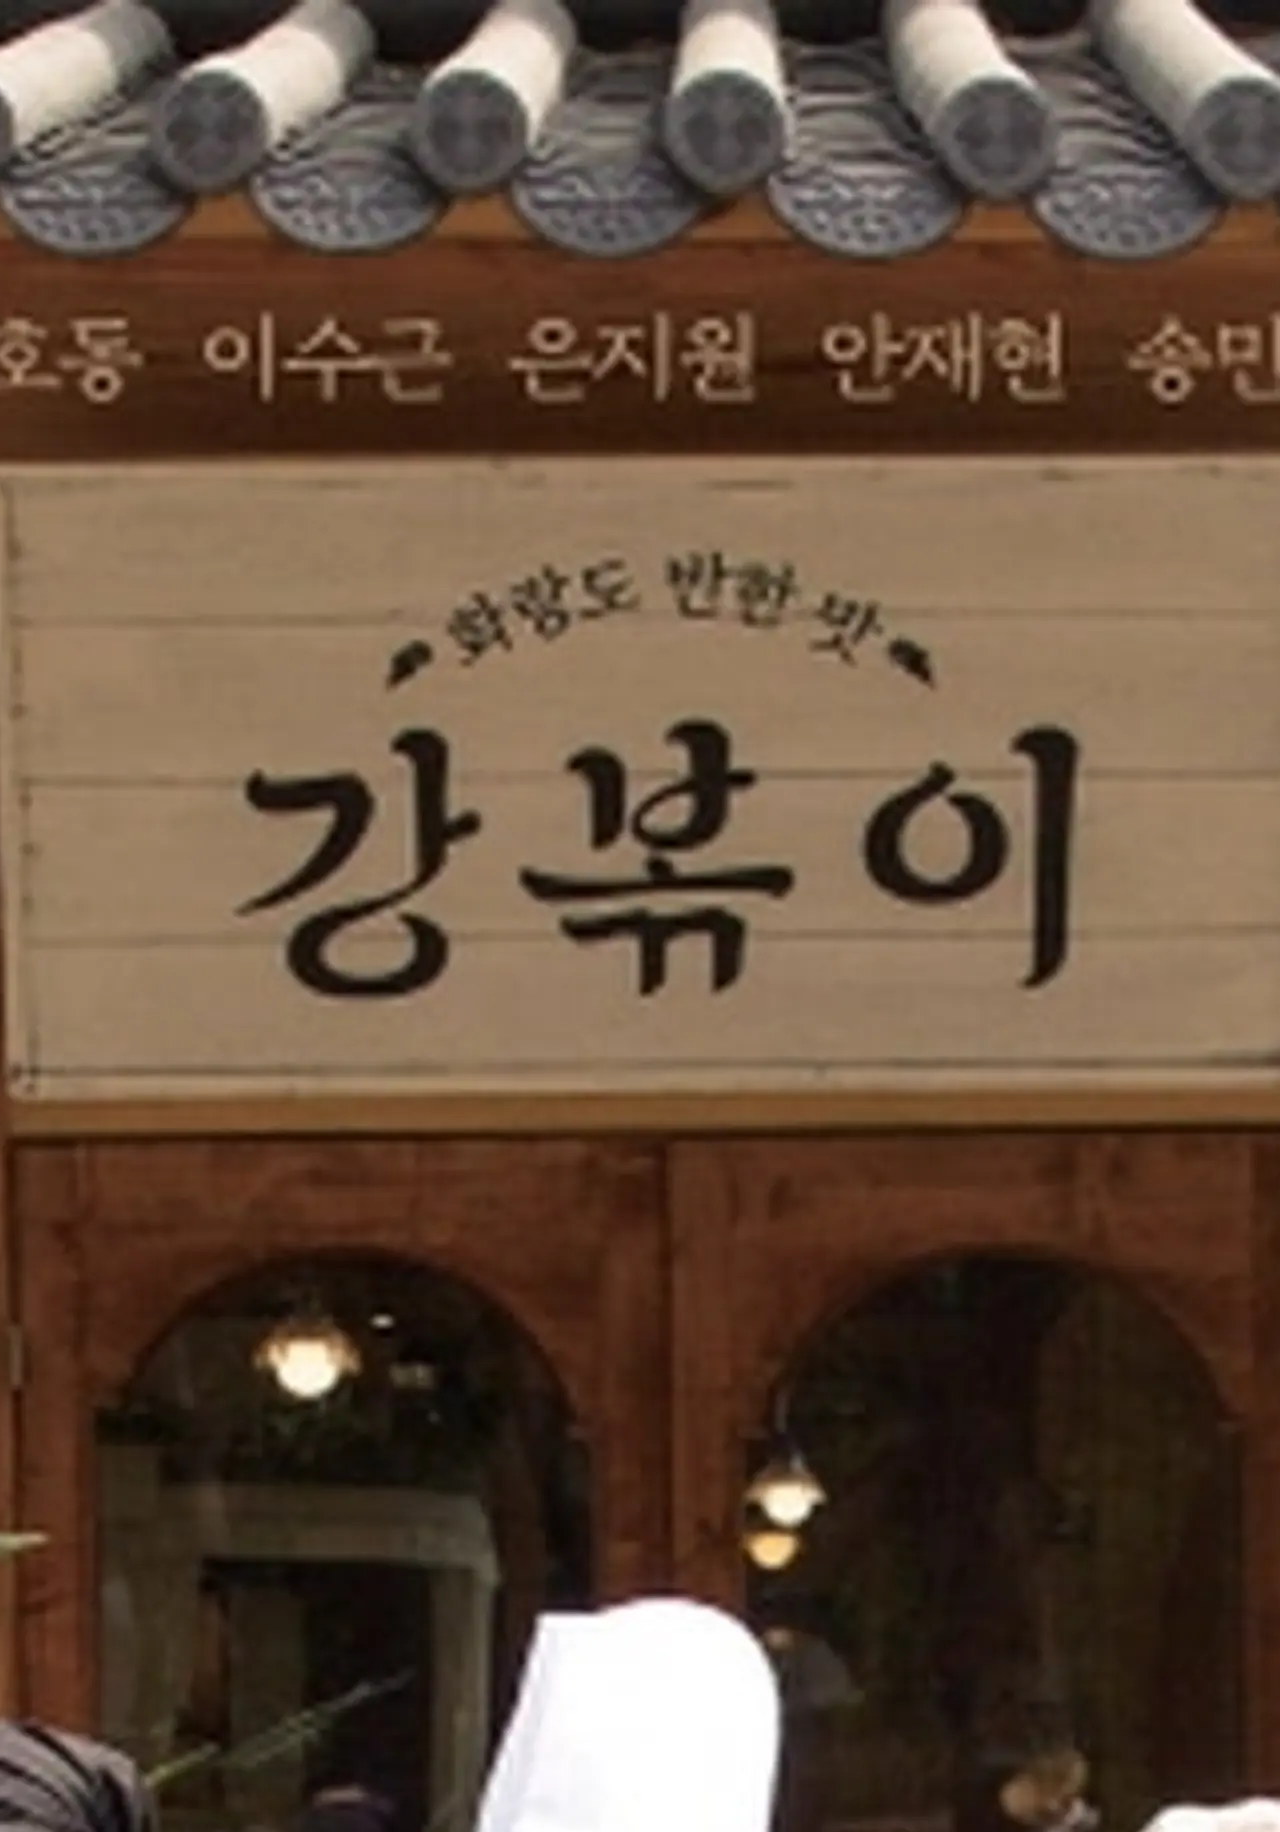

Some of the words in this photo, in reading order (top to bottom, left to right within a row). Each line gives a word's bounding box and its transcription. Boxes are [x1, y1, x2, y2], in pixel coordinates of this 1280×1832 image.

[446, 557, 641, 668] 화랑도
[666, 549, 800, 628] 반한
[808, 592, 885, 667] 맛
[235, 719, 1079, 999] 강볶이
